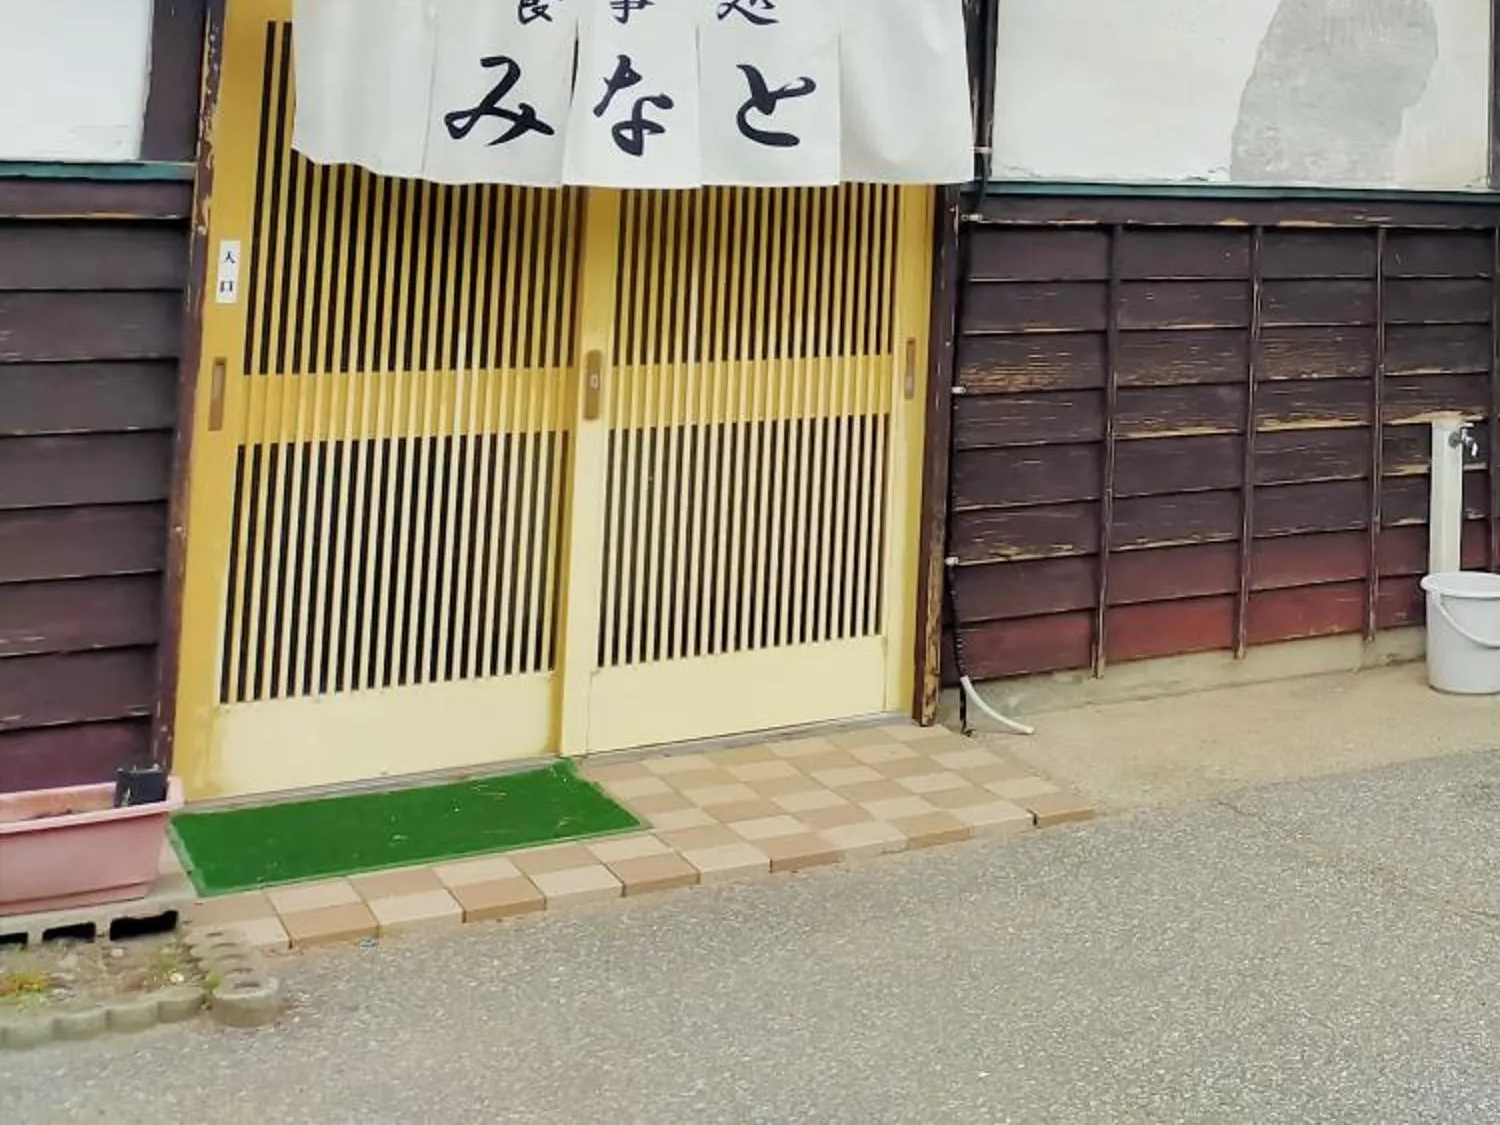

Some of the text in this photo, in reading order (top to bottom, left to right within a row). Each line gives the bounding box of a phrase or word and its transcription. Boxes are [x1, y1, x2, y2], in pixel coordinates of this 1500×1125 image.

[444, 54, 818, 157] みなと
[220, 251, 236, 293] 入口
